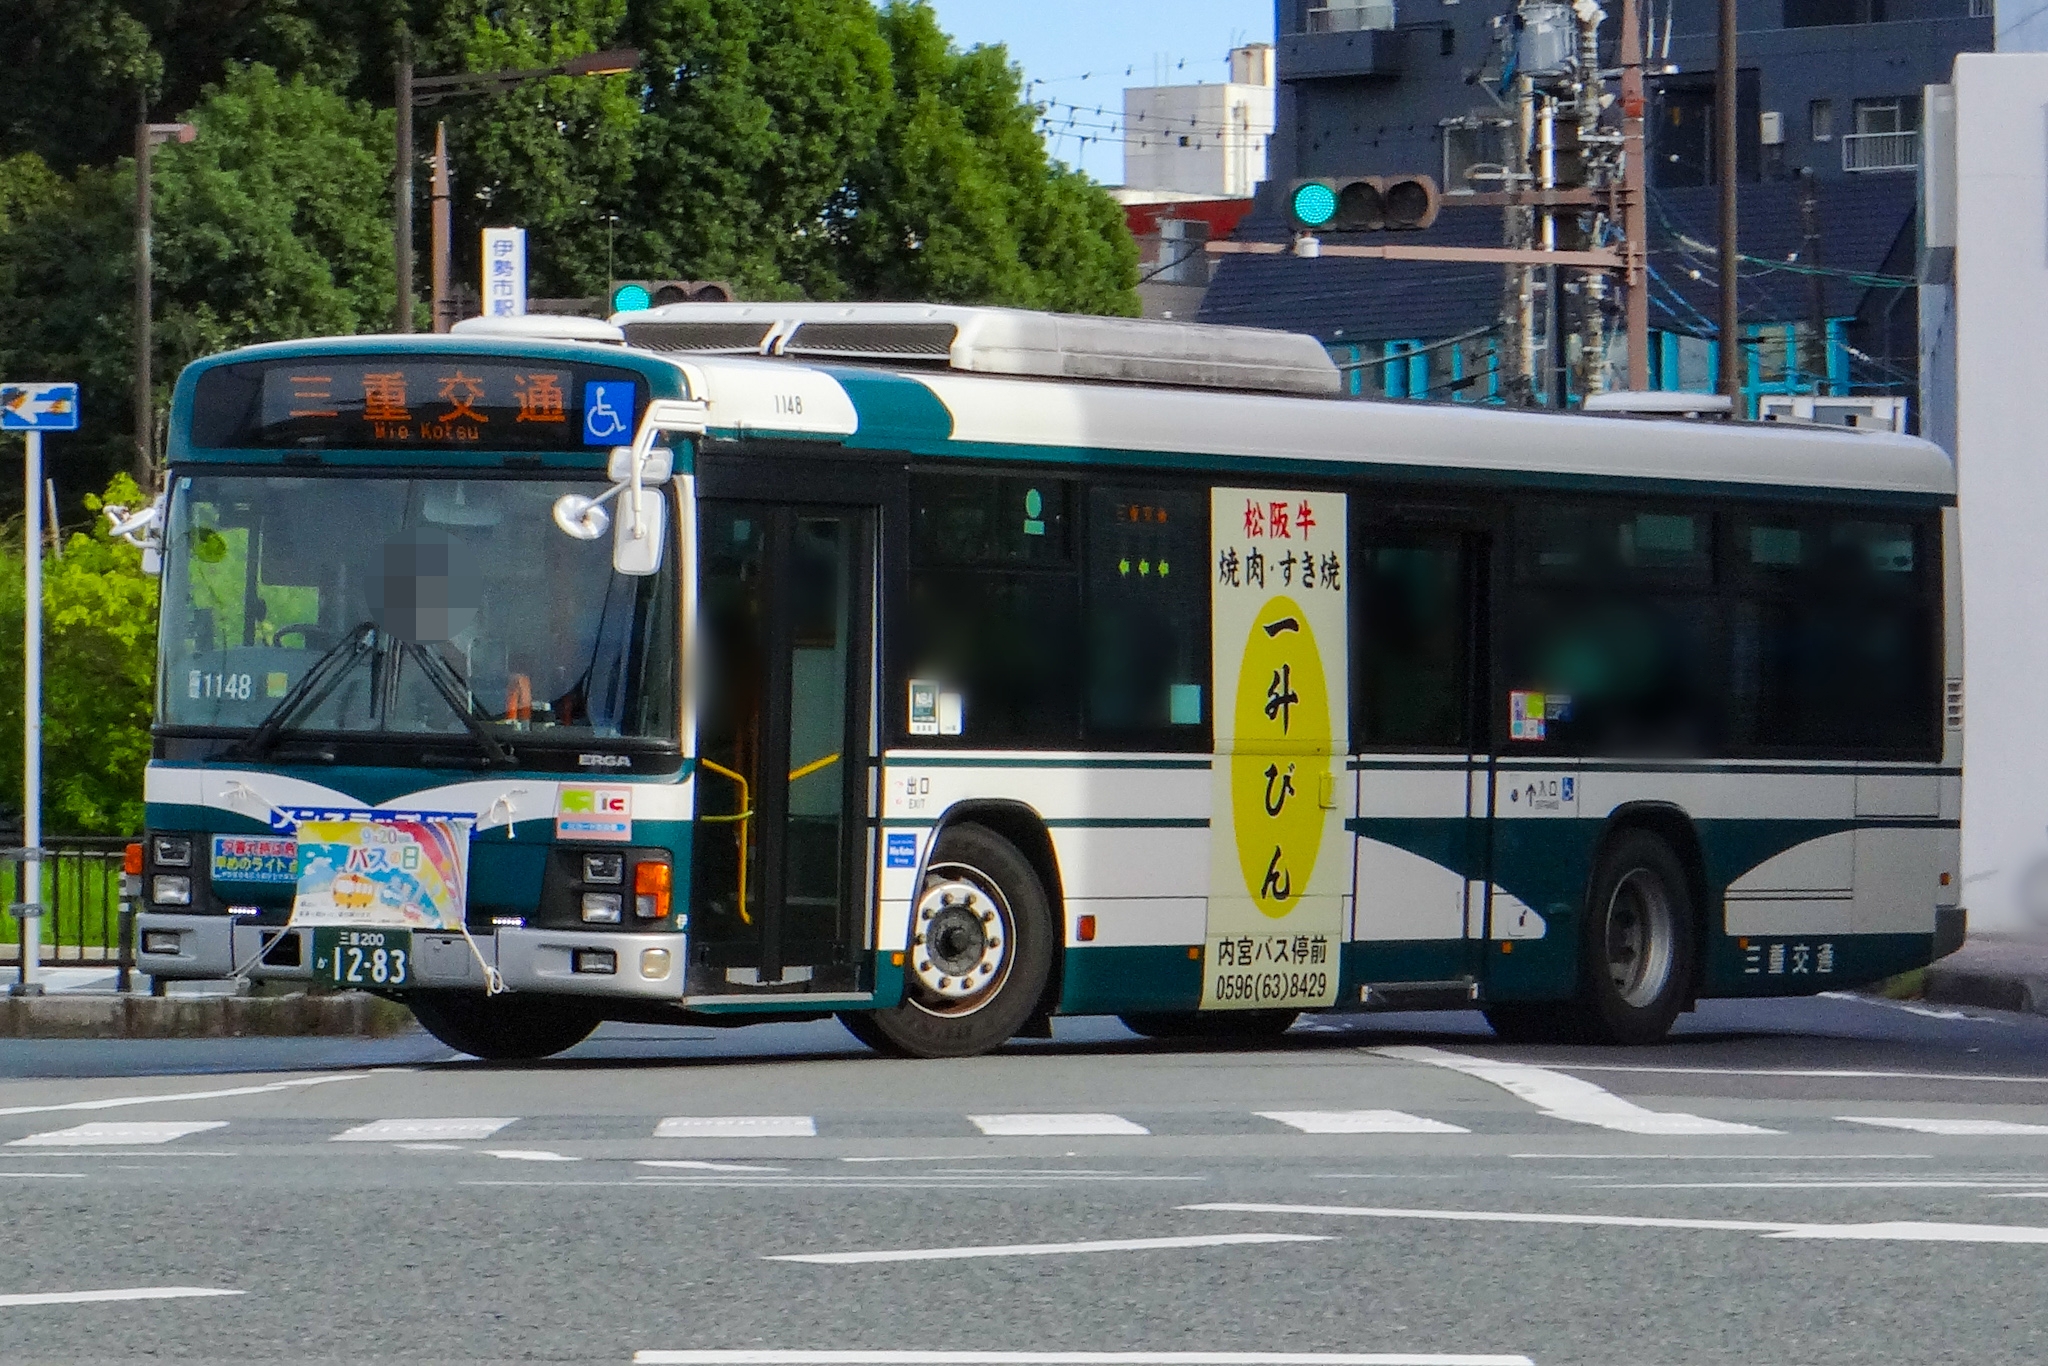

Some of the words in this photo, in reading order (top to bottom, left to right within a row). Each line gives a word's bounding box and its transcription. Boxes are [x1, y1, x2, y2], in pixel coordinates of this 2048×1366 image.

[290, 370, 566, 423] 三重交通
[774, 394, 803, 415] 1148
[374, 421, 409, 440] Mie
[420, 421, 480, 440] Kotsu
[1243, 498, 1317, 541] 松阪牛
[1219, 546, 1342, 592] 焼肉・すき焼
[203, 673, 252, 700] 1148
[578, 753, 632, 768] ERGA
[1260, 616, 1300, 901] 一升びん
[906, 776, 930, 795] 出口
[348, 845, 420, 870] バスの日
[332, 946, 407, 985] 12-83
[1217, 934, 1329, 968] 内宮バス停前
[1744, 942, 1836, 975] 三重交通
[1216, 971, 1328, 1003] 0596(63)8429
